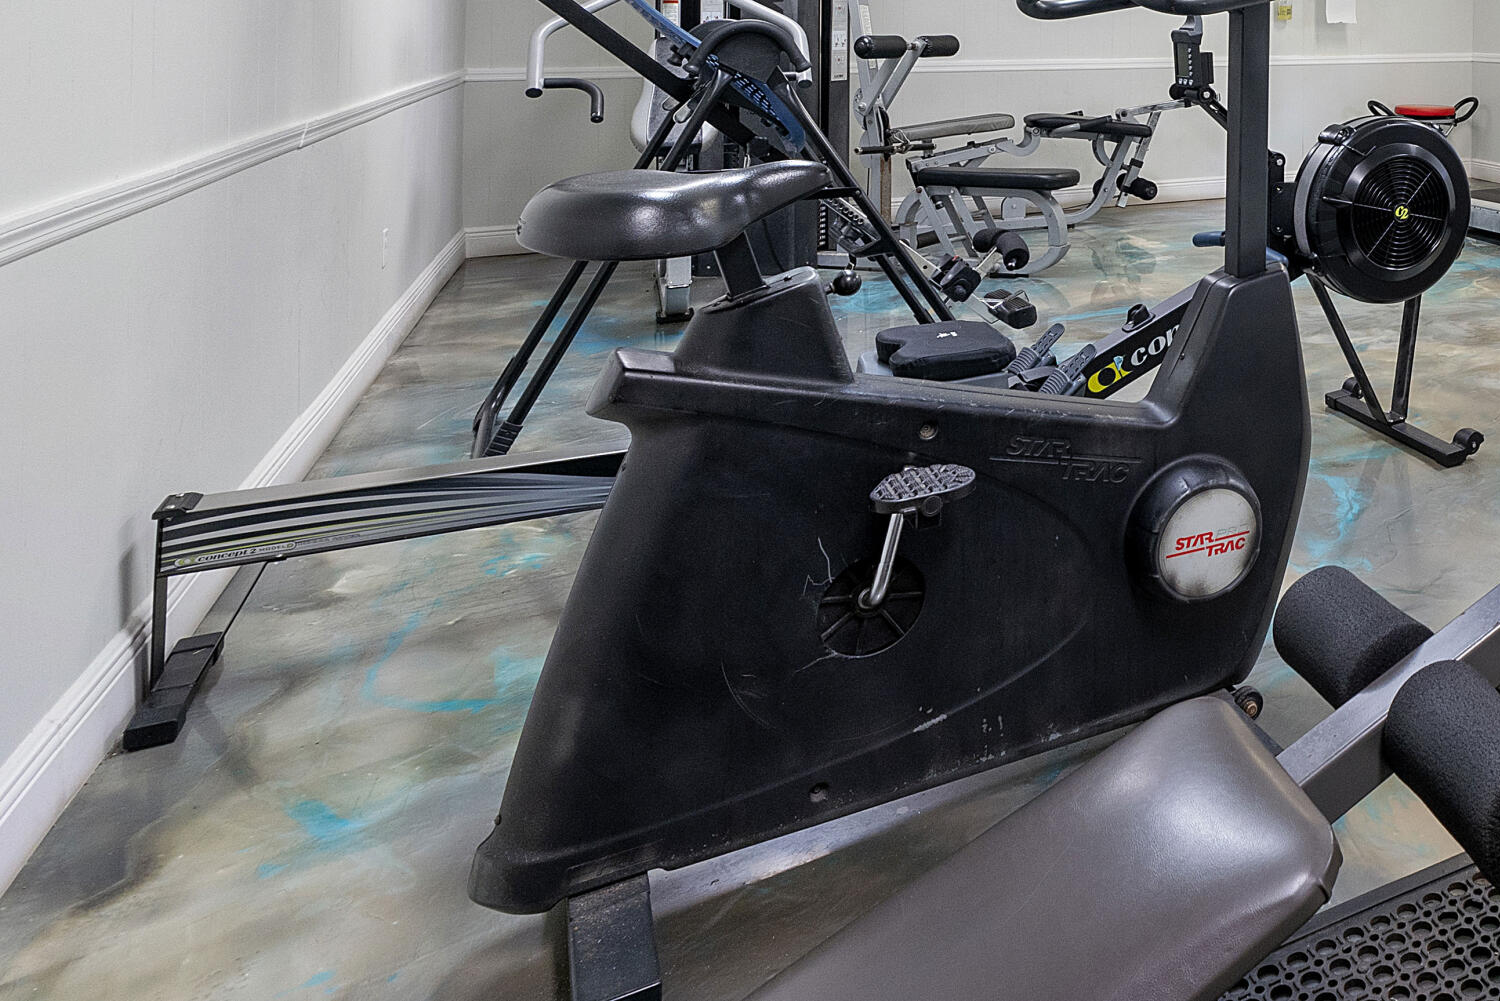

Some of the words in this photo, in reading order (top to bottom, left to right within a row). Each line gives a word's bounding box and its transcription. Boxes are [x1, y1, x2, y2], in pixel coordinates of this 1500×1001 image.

[1006, 435, 1071, 457] STAR
[1061, 462, 1130, 483] TRAC
[1175, 531, 1214, 551] STAR
[1205, 537, 1246, 557] TRAC
